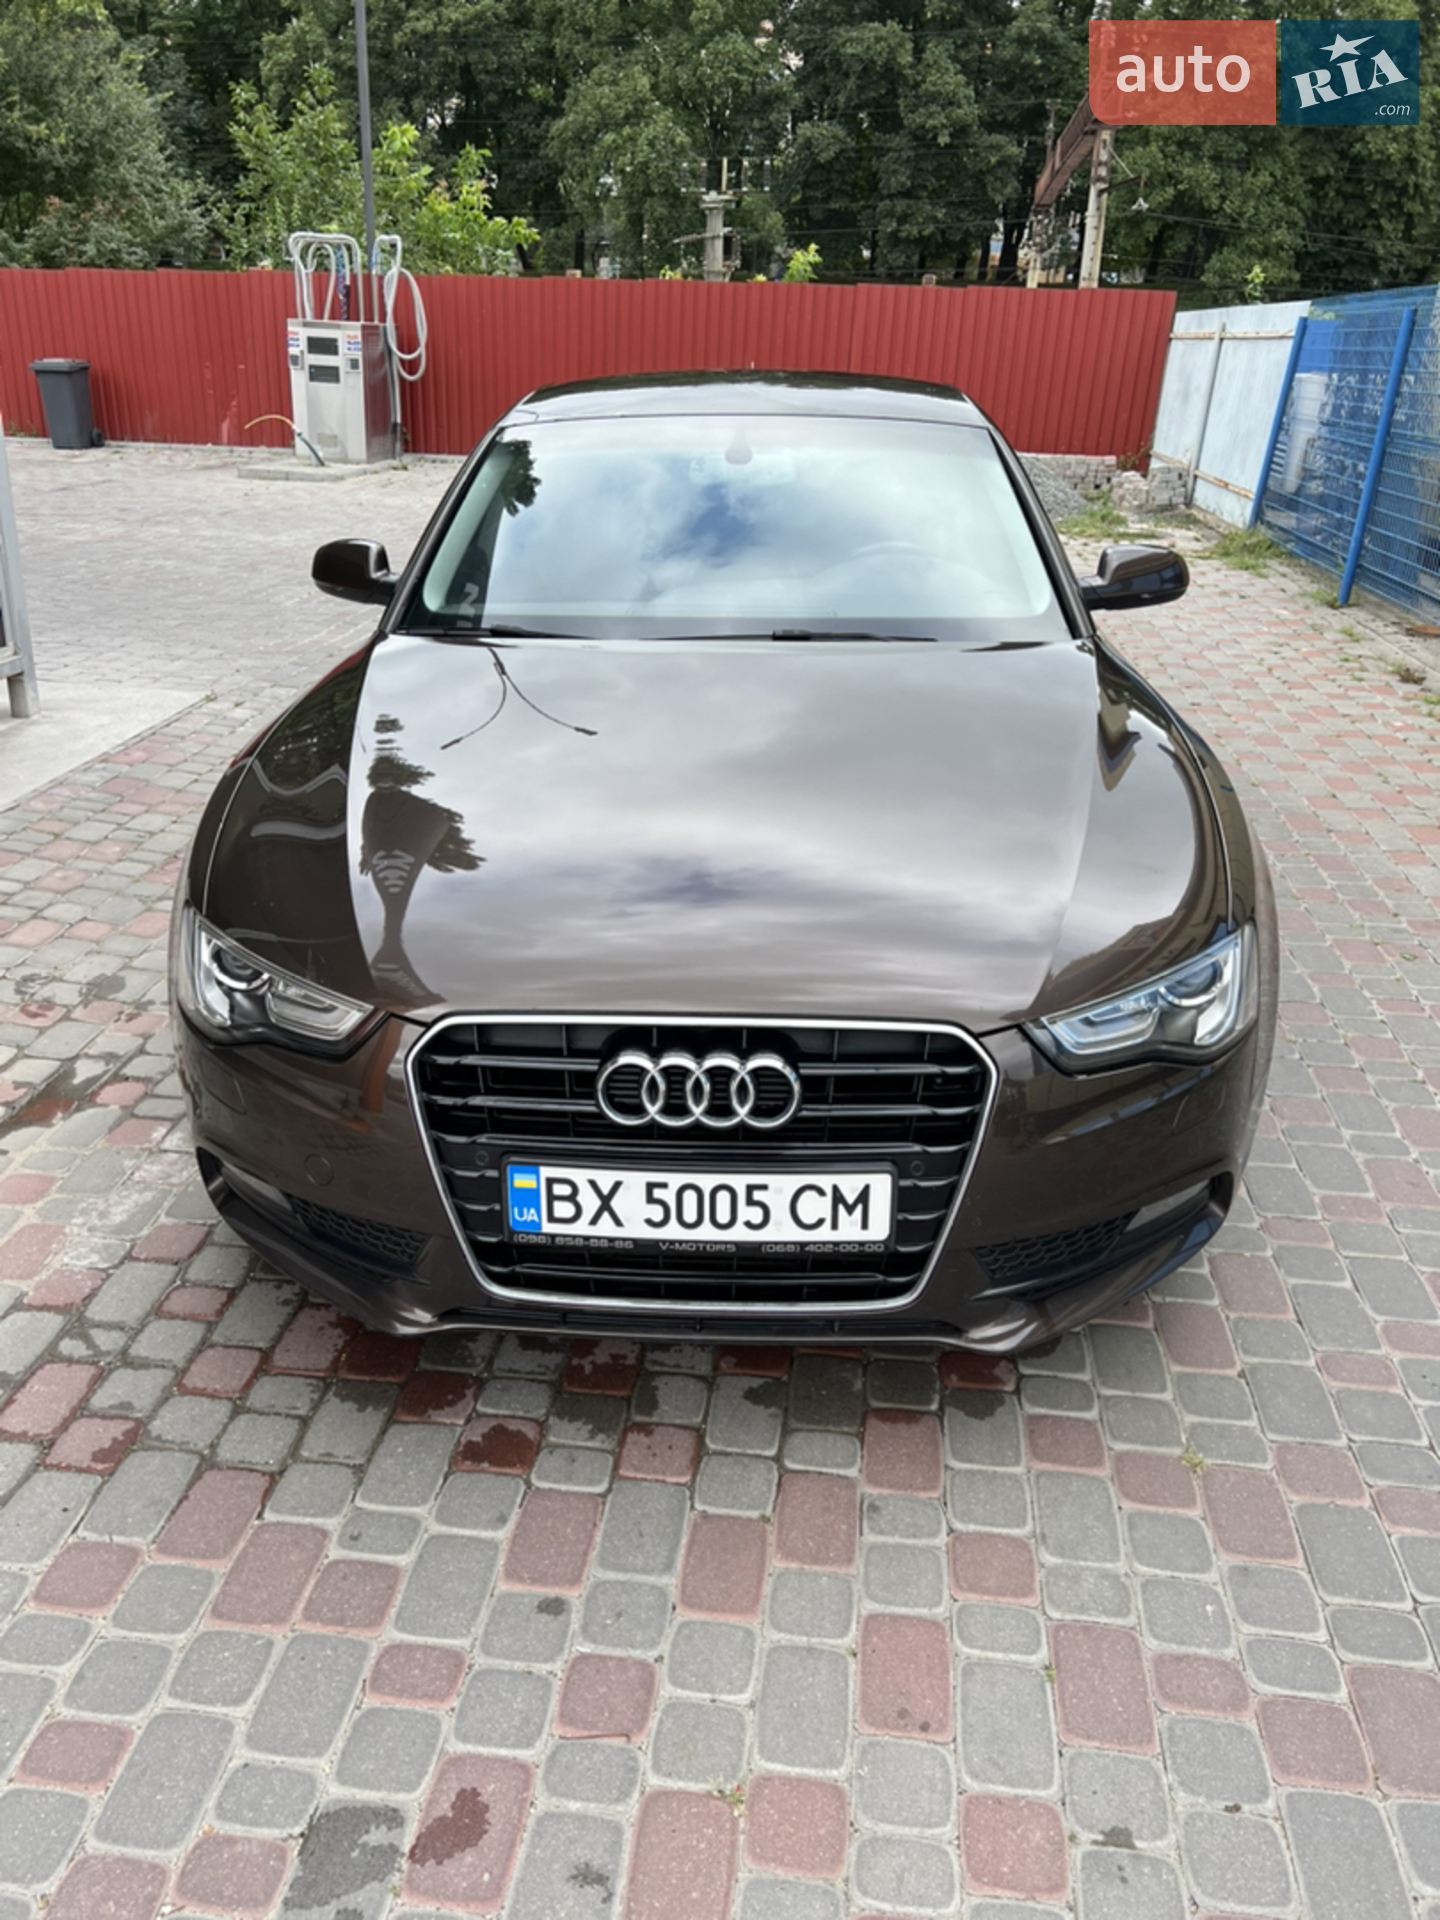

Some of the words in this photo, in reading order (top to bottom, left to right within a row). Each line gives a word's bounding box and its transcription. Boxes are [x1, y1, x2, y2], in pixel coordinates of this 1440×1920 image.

[545, 1177, 625, 1228] BX
[644, 1181, 771, 1231] 5005
[789, 1183, 871, 1231] CM
[514, 1206, 539, 1223] UA
[659, 1241, 737, 1252] V-MOTORS
[761, 1242, 800, 1253] (068)
[804, 1242, 885, 1252] 402-00-00
